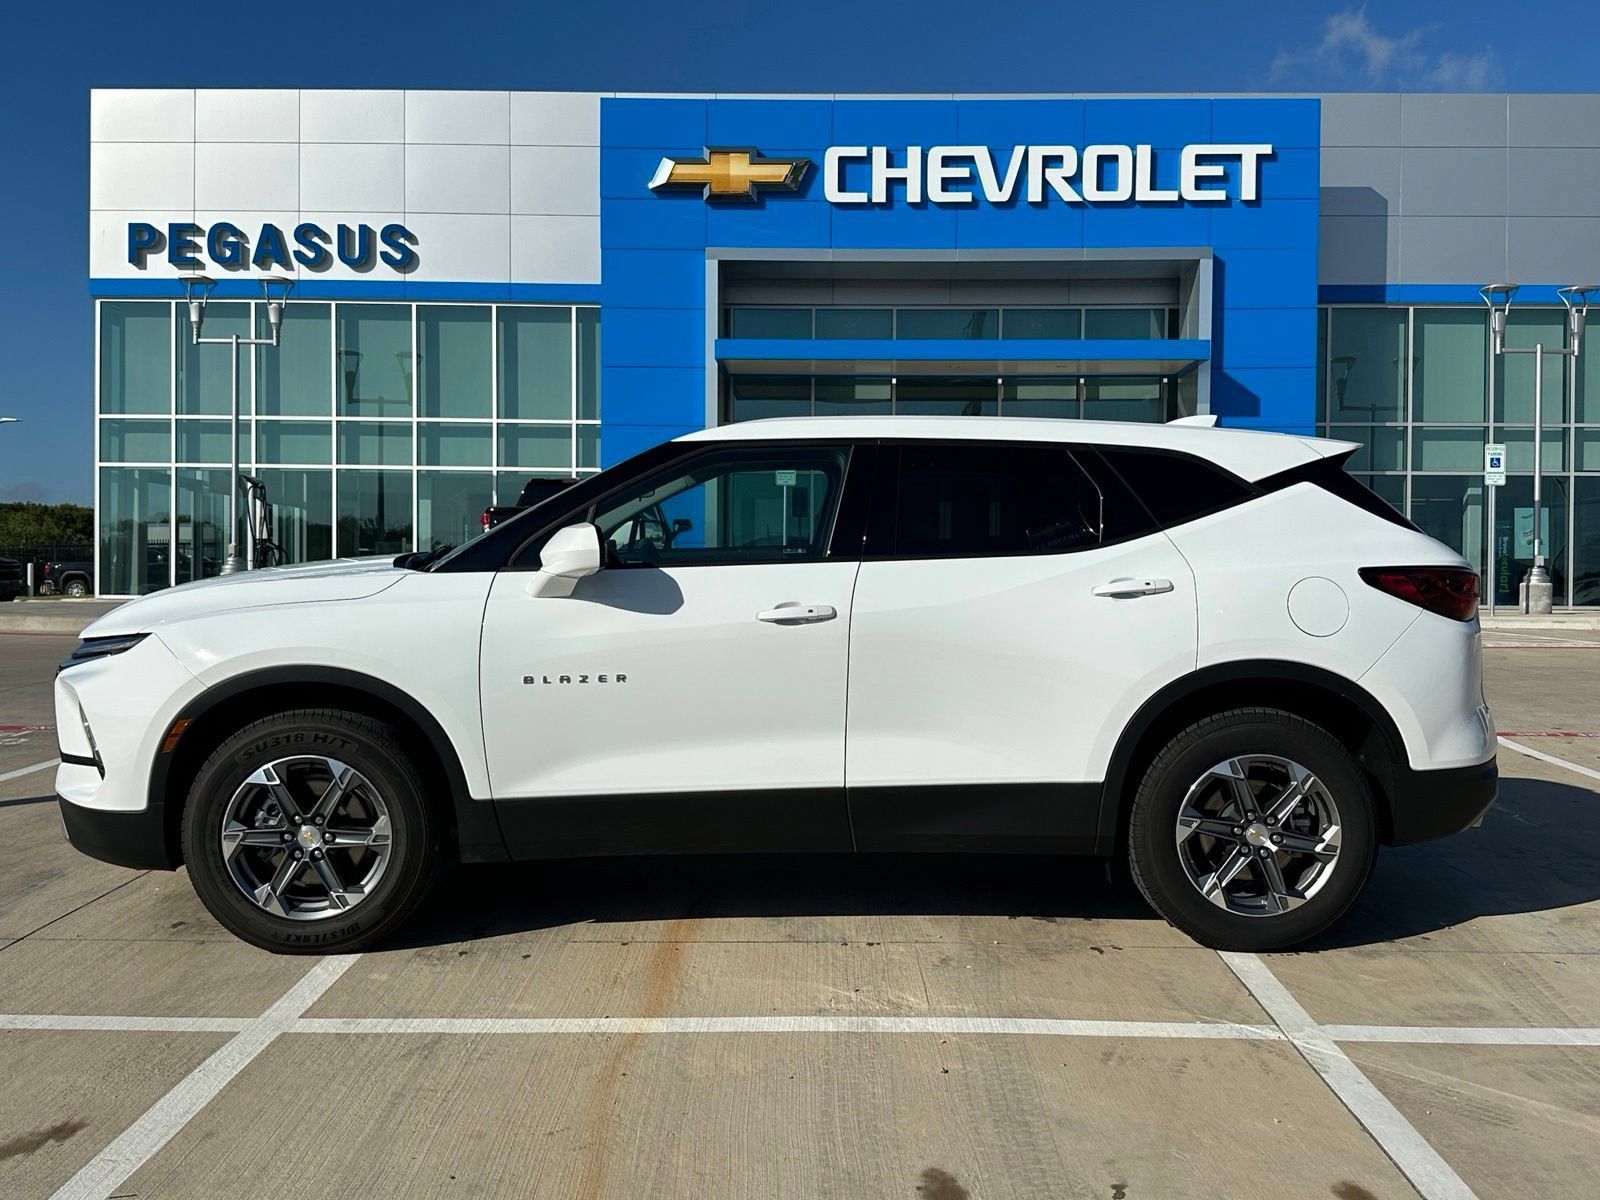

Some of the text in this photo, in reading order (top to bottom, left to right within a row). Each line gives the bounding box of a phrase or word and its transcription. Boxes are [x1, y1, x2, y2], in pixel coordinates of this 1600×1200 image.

[824, 144, 1273, 203] CHEVROLET
[128, 222, 417, 270] PEGASUS
[523, 674, 627, 684] BLAZER
[241, 733, 350, 759] SU318 H/T
[283, 921, 360, 943] WESTLAKE
